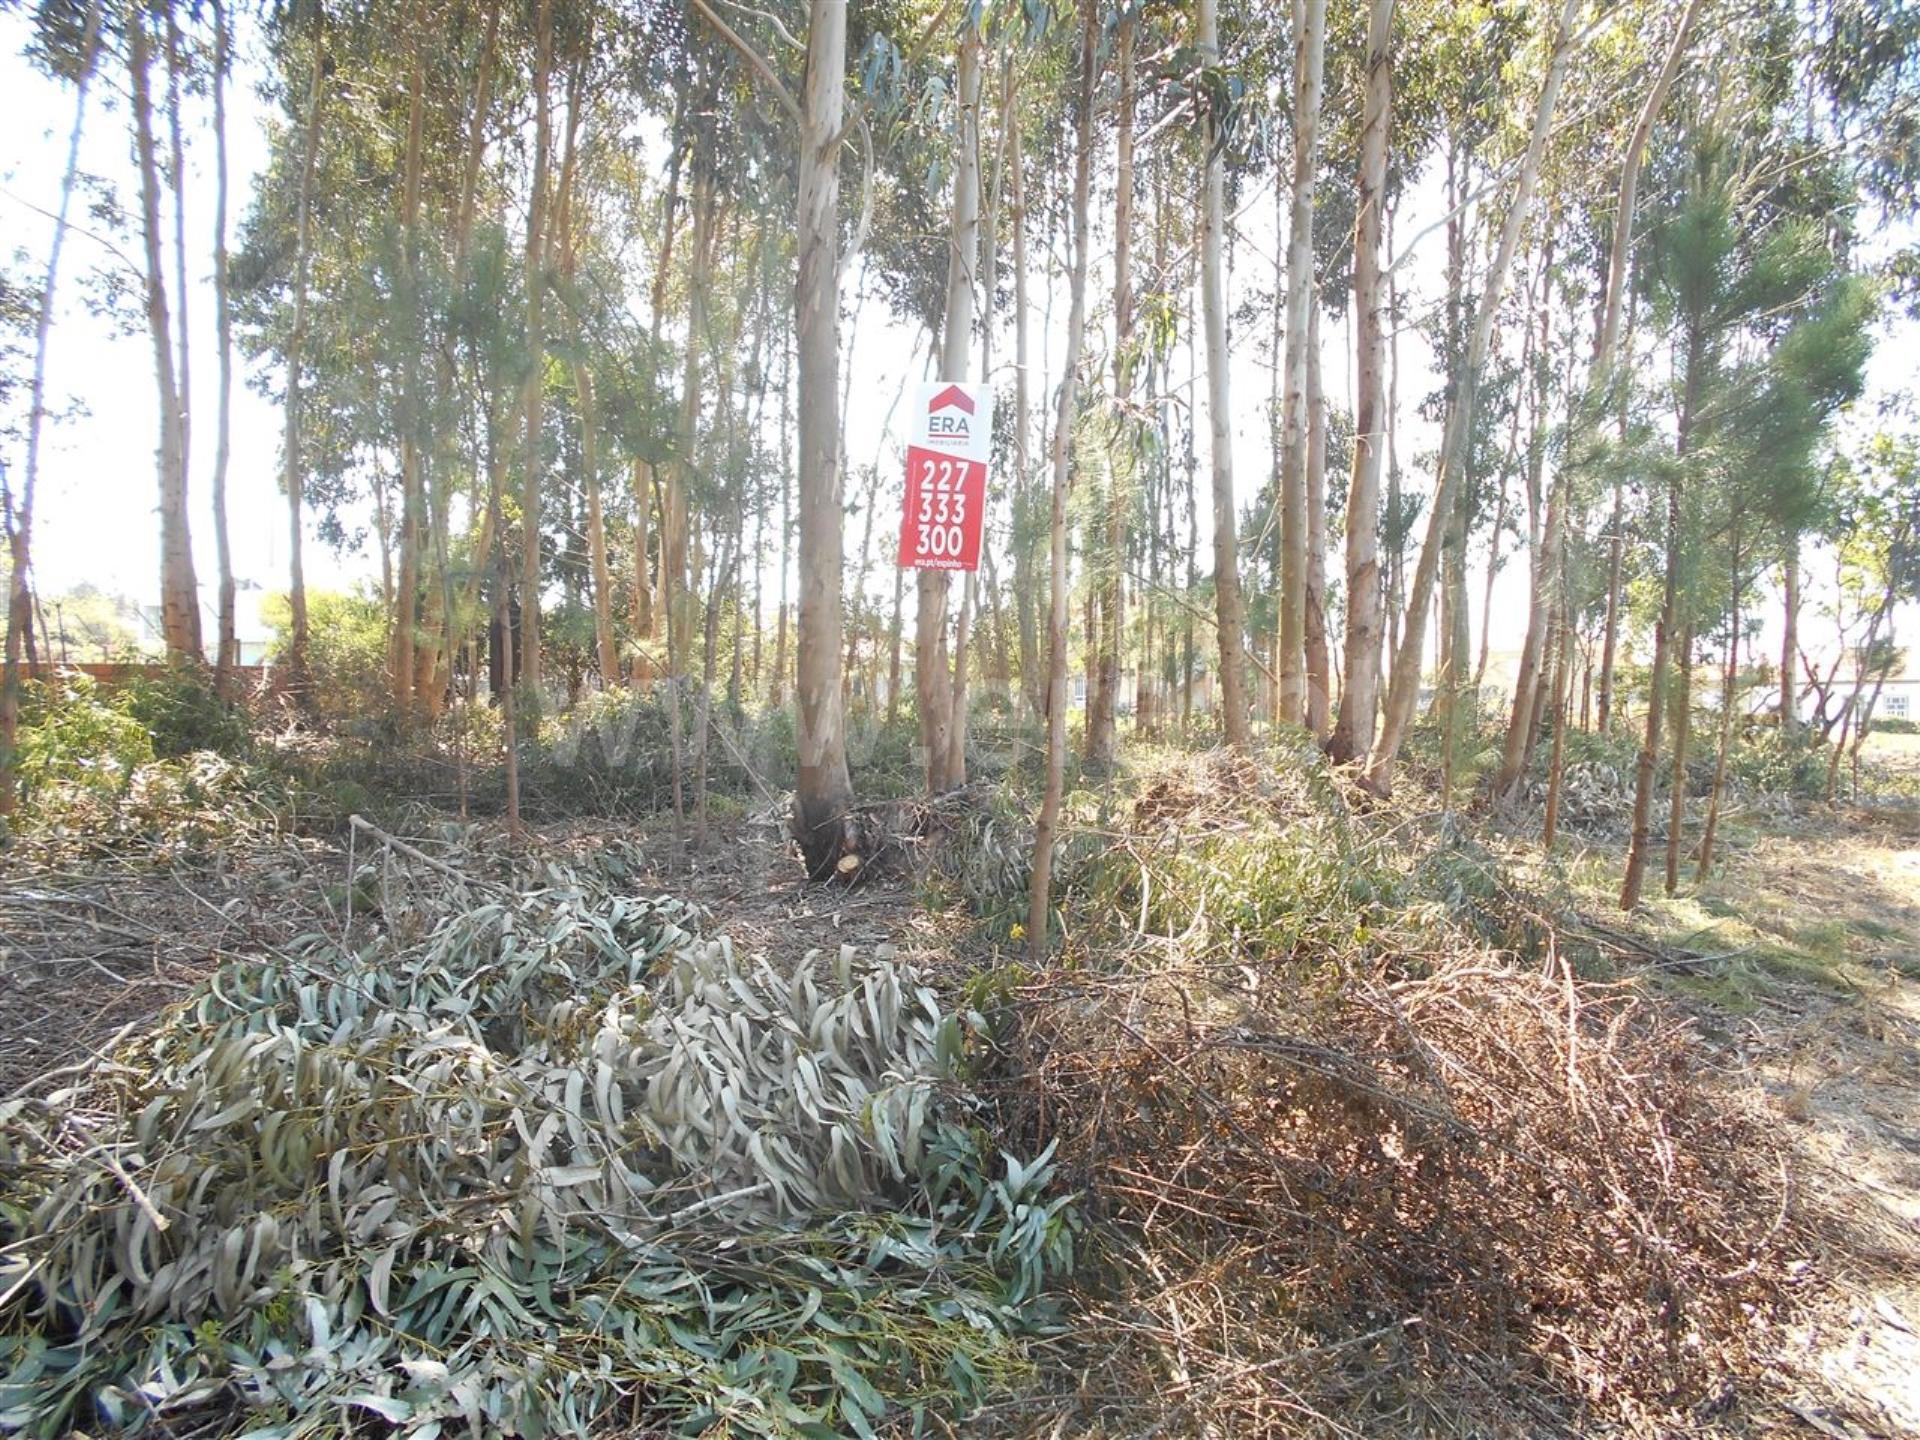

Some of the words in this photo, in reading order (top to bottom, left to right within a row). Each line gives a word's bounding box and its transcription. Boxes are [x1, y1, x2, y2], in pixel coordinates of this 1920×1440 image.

[928, 417, 970, 433] ERA
[920, 460, 969, 491] 227
[918, 492, 966, 524] 333
[915, 524, 963, 556] 300
